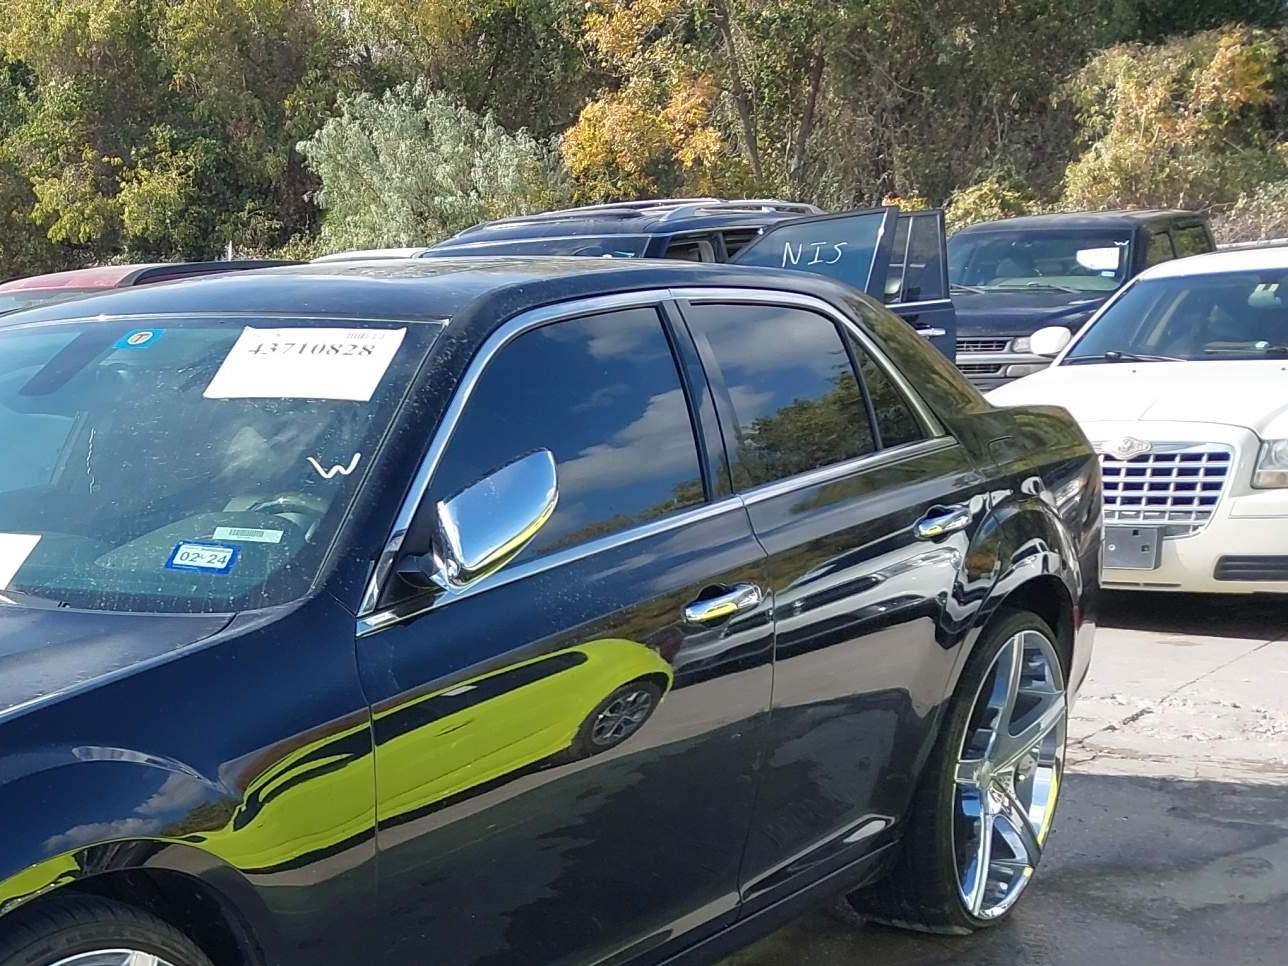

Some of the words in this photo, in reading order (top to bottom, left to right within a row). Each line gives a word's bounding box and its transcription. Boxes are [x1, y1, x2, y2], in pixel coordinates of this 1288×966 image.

[248, 342, 376, 356] 43710828
[306, 452, 361, 479] W
[179, 551, 200, 563] 02
[206, 553, 228, 566] 24
